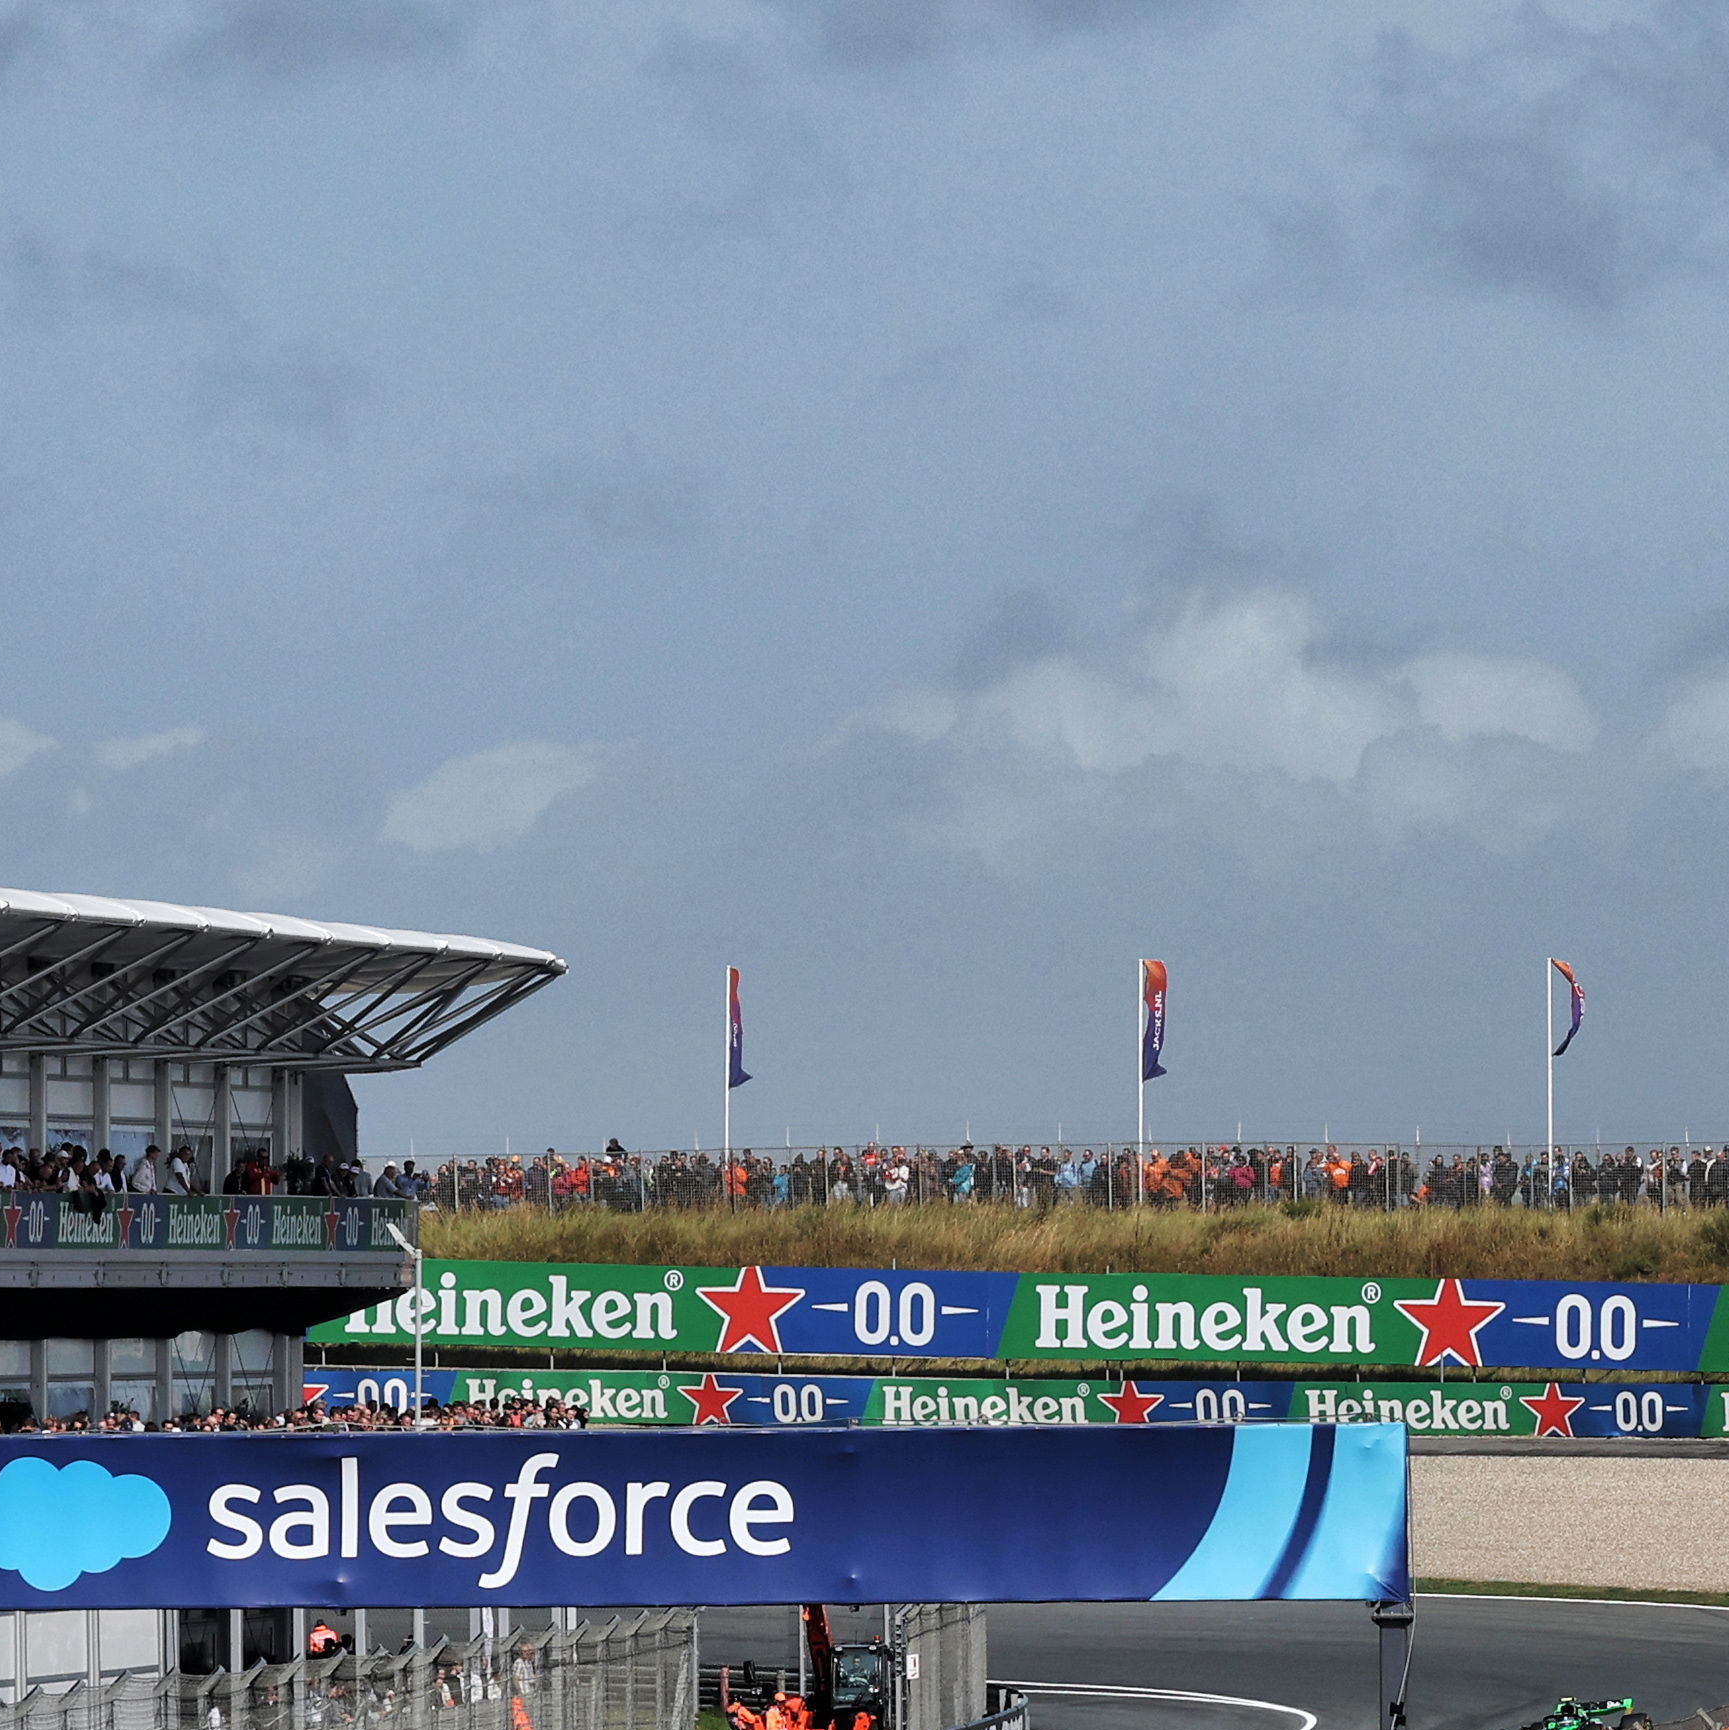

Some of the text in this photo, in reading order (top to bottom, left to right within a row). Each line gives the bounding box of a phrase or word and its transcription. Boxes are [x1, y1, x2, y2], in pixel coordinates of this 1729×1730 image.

[853, 1280, 935, 1346] 0.0
[1556, 1294, 1637, 1361] 0.0
[773, 1384, 823, 1423] 0.0
[1616, 1391, 1663, 1433] 0.0
[209, 1452, 794, 1590] salesforce
